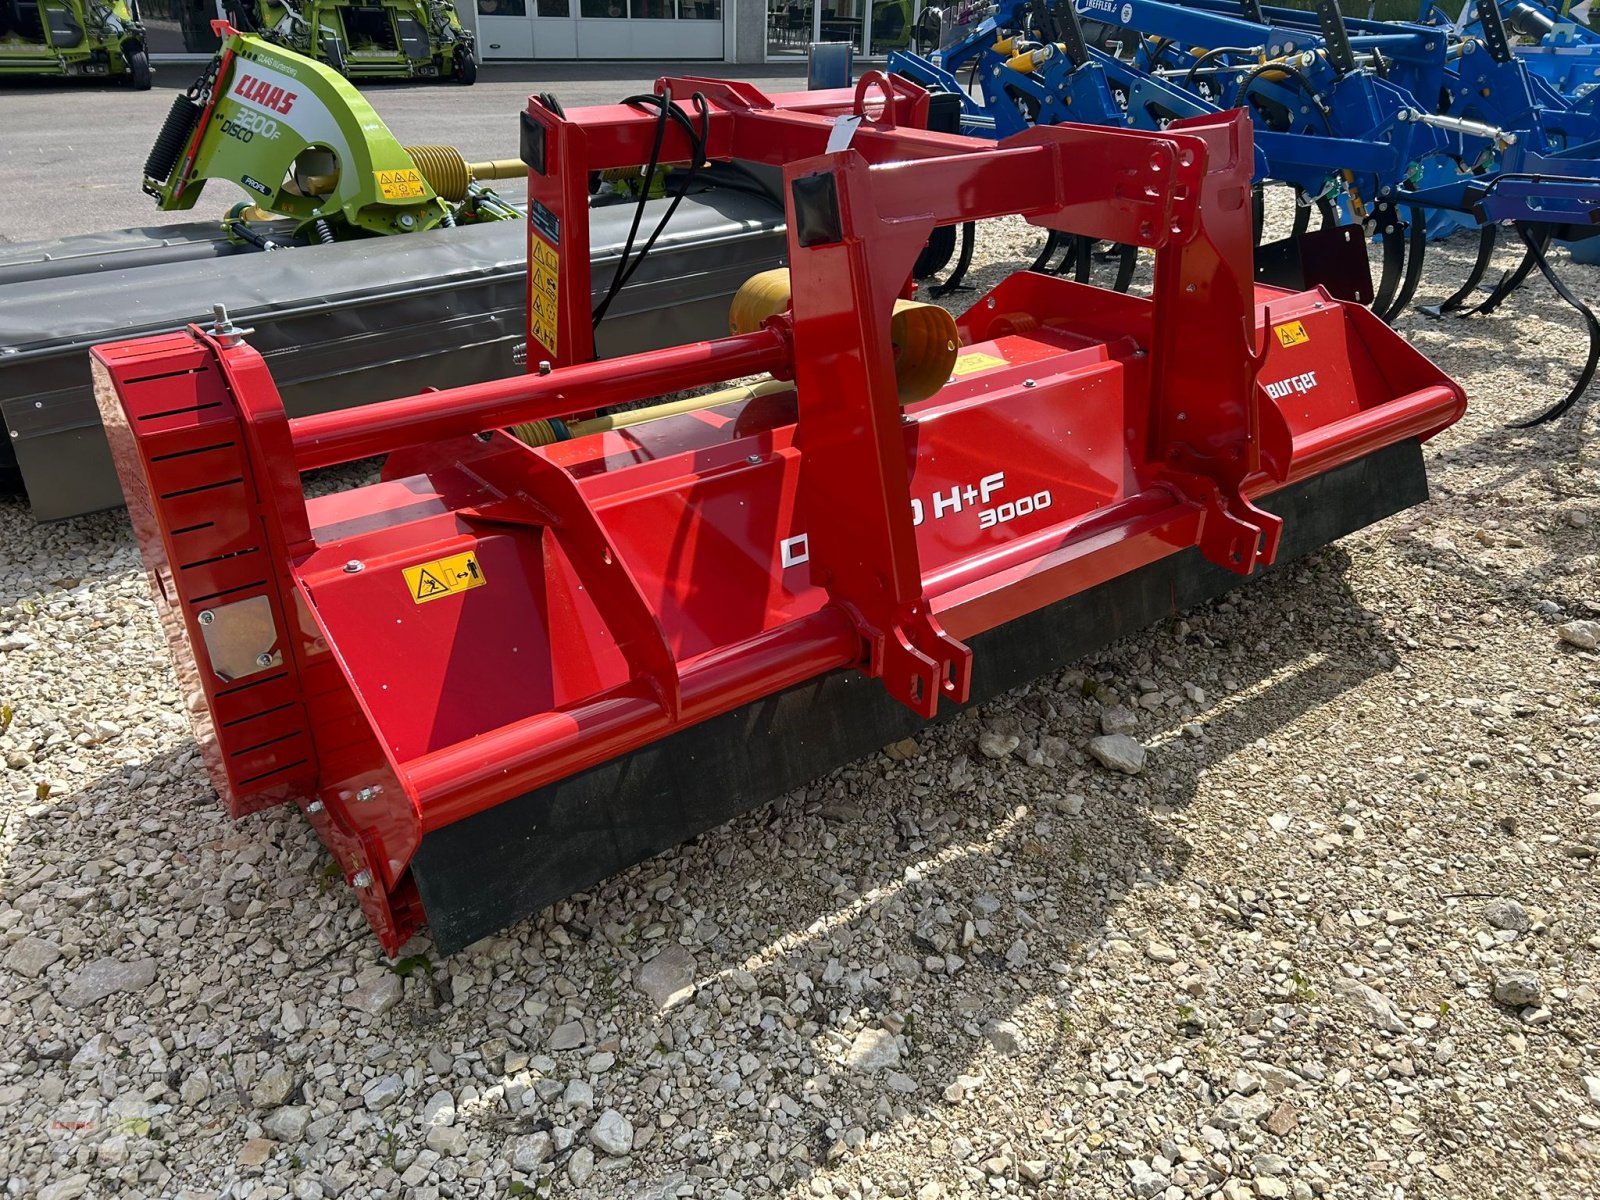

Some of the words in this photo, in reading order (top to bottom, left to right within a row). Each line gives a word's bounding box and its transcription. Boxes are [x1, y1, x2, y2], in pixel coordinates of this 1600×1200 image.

[258, 53, 274, 66] CLAAS
[234, 74, 298, 115] CLAAS
[220, 120, 254, 143] DISCO
[245, 177, 266, 194] PROFIL
[932, 471, 1006, 519] H+F
[977, 490, 1052, 530] 3000
